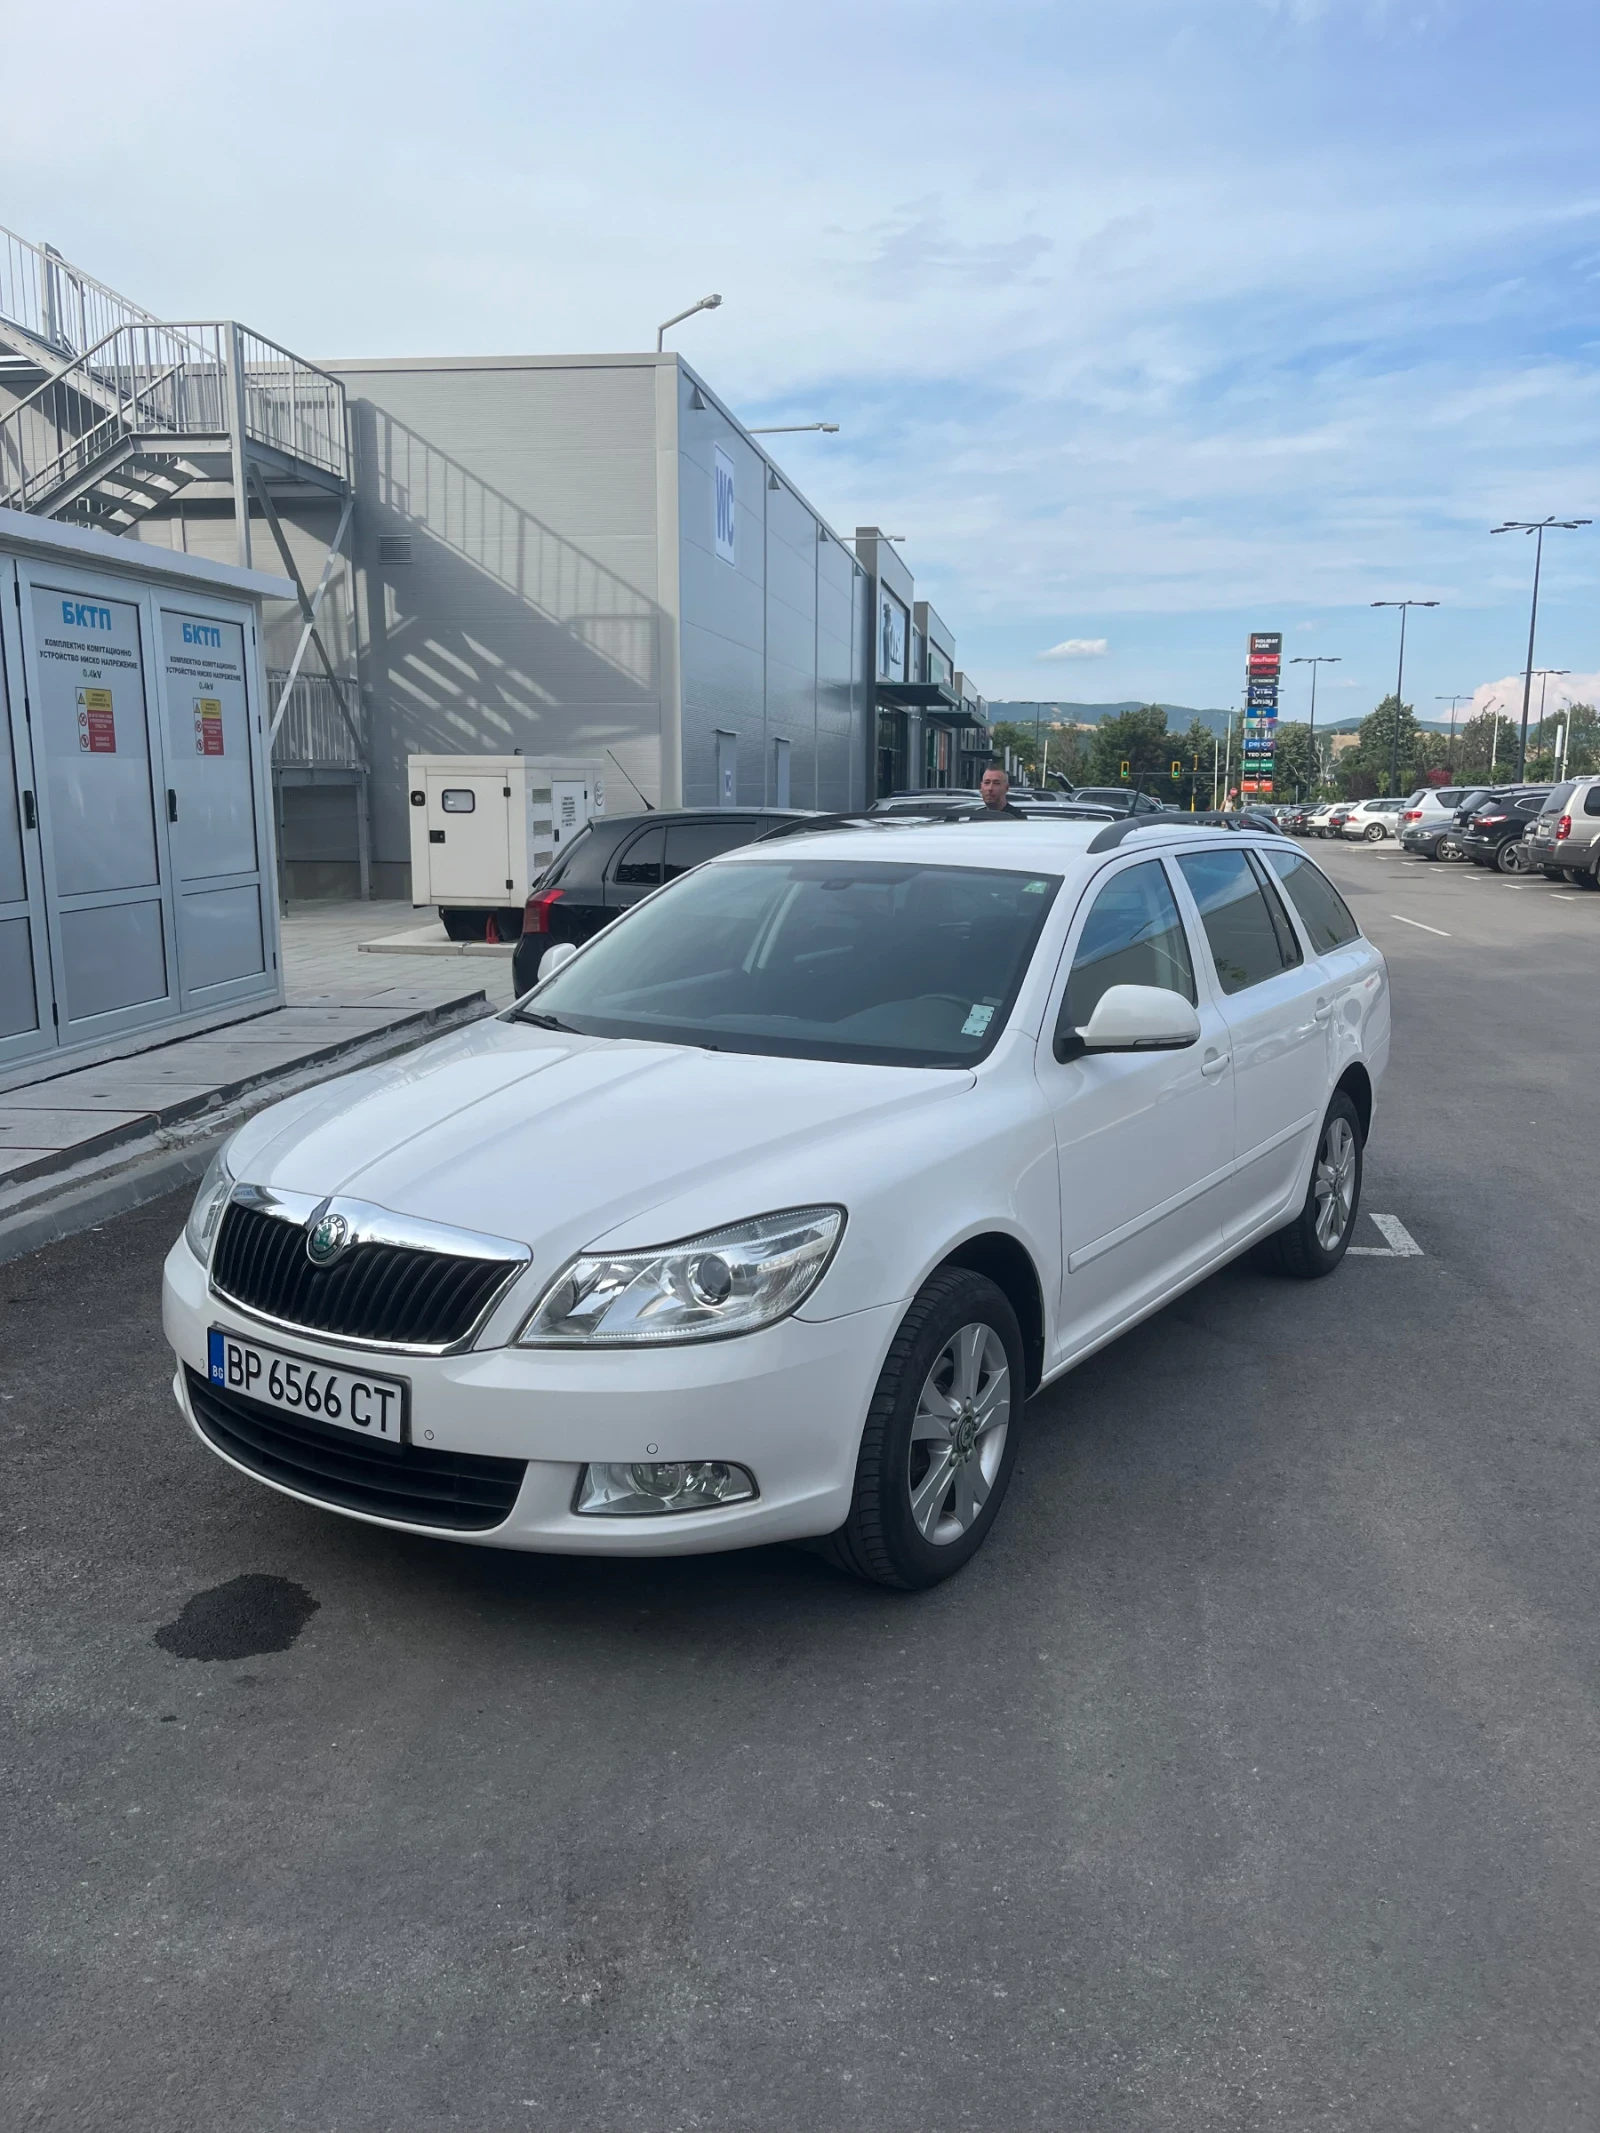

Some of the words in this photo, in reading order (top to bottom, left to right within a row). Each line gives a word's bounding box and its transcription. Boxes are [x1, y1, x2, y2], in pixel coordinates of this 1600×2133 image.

[715, 465, 734, 547] WC
[62, 600, 112, 631] БКТП
[182, 622, 221, 648] БКТП
[44, 638, 86, 651] КОМПЛЕКТНО
[86, 644, 132, 657] КОМУТАЦИОННО
[39, 650, 80, 662] УСТРОЙСТВО
[80, 655, 100, 665] НИСКО
[100, 658, 139, 669] НАПРЕЖЕНИЕ
[165, 666, 197, 676] УСТРОЙСТВО
[212, 1364, 224, 1379] BG
[227, 1343, 262, 1390] BP
[268, 1359, 342, 1418] 6566
[350, 1382, 396, 1432] CT
